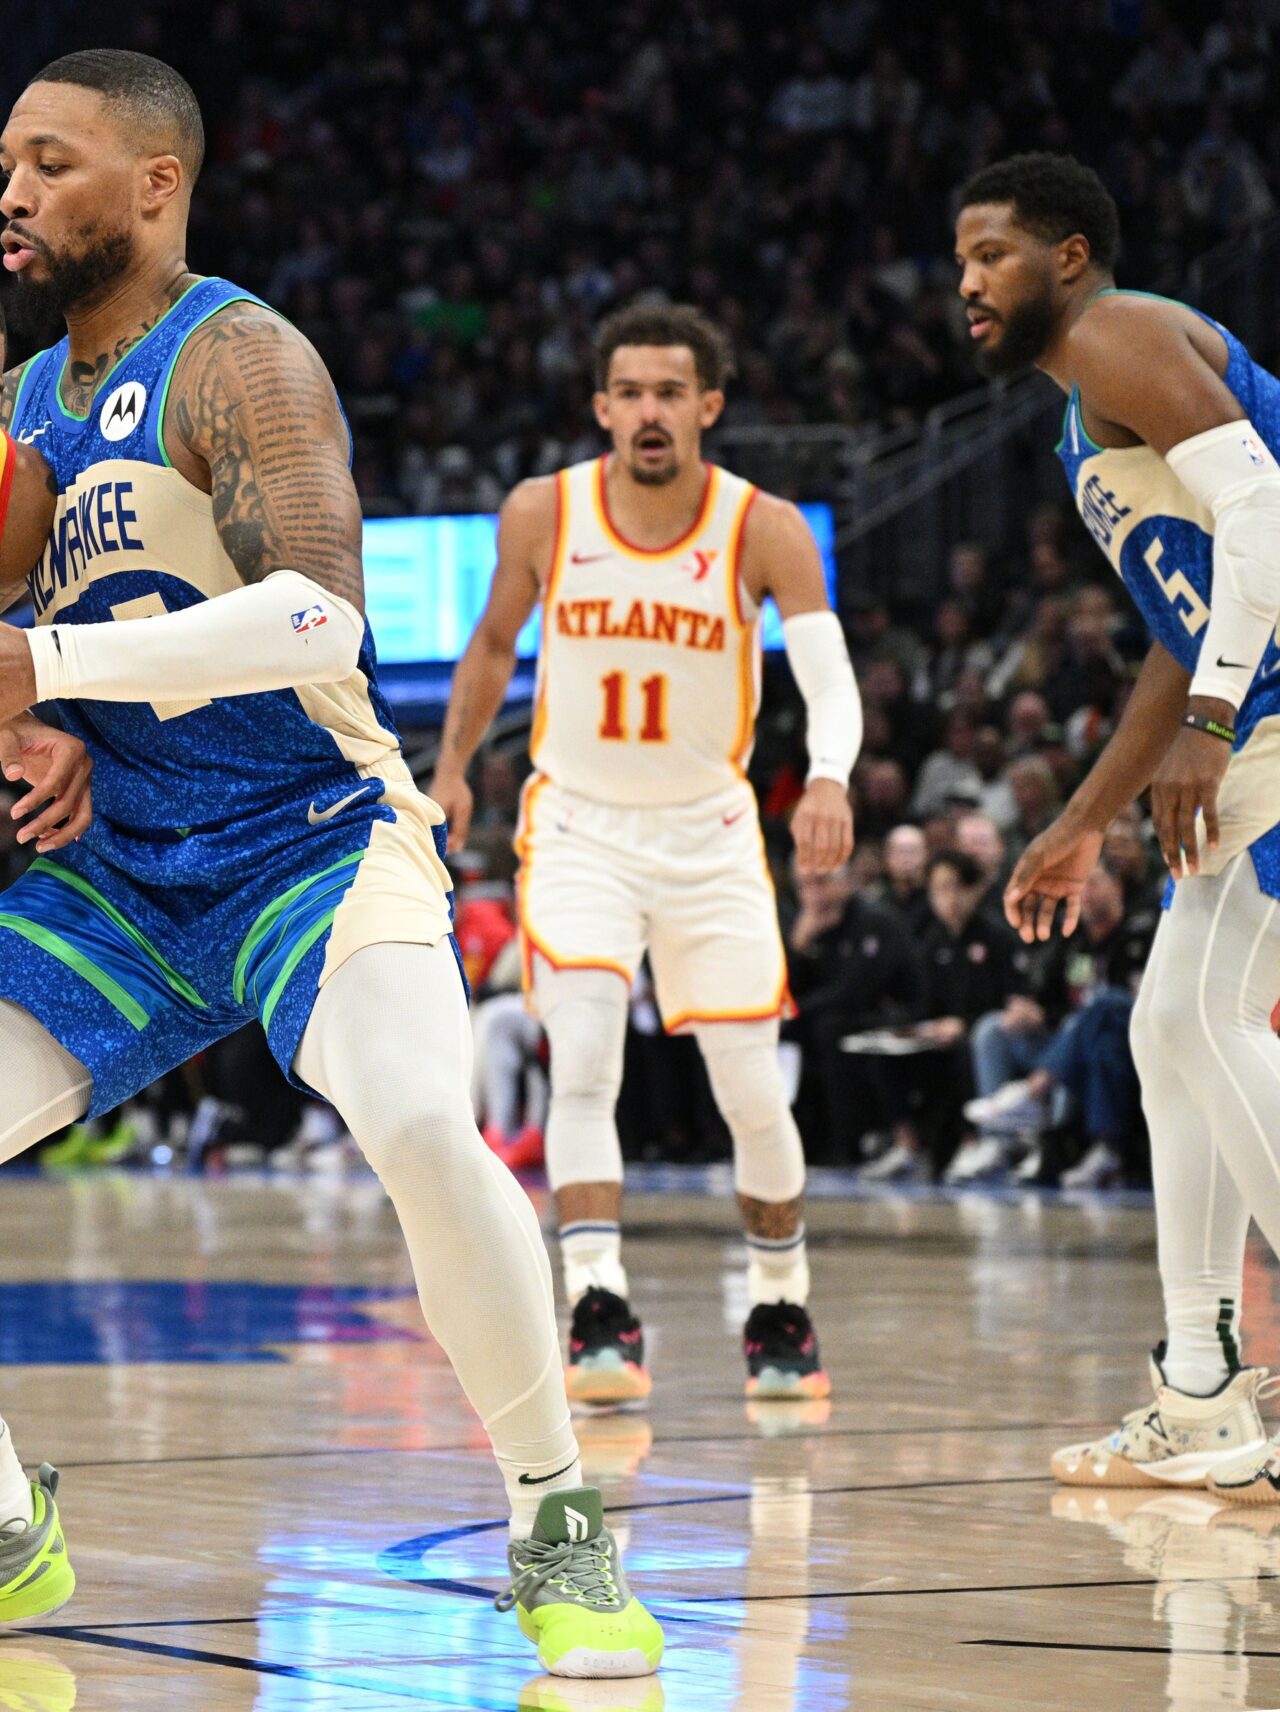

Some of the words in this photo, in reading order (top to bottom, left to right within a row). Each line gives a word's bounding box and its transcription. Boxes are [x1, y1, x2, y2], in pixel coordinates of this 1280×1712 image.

[1142, 535, 1212, 639] 5
[556, 597, 727, 652] ATLANTA
[598, 670, 670, 744] 11
